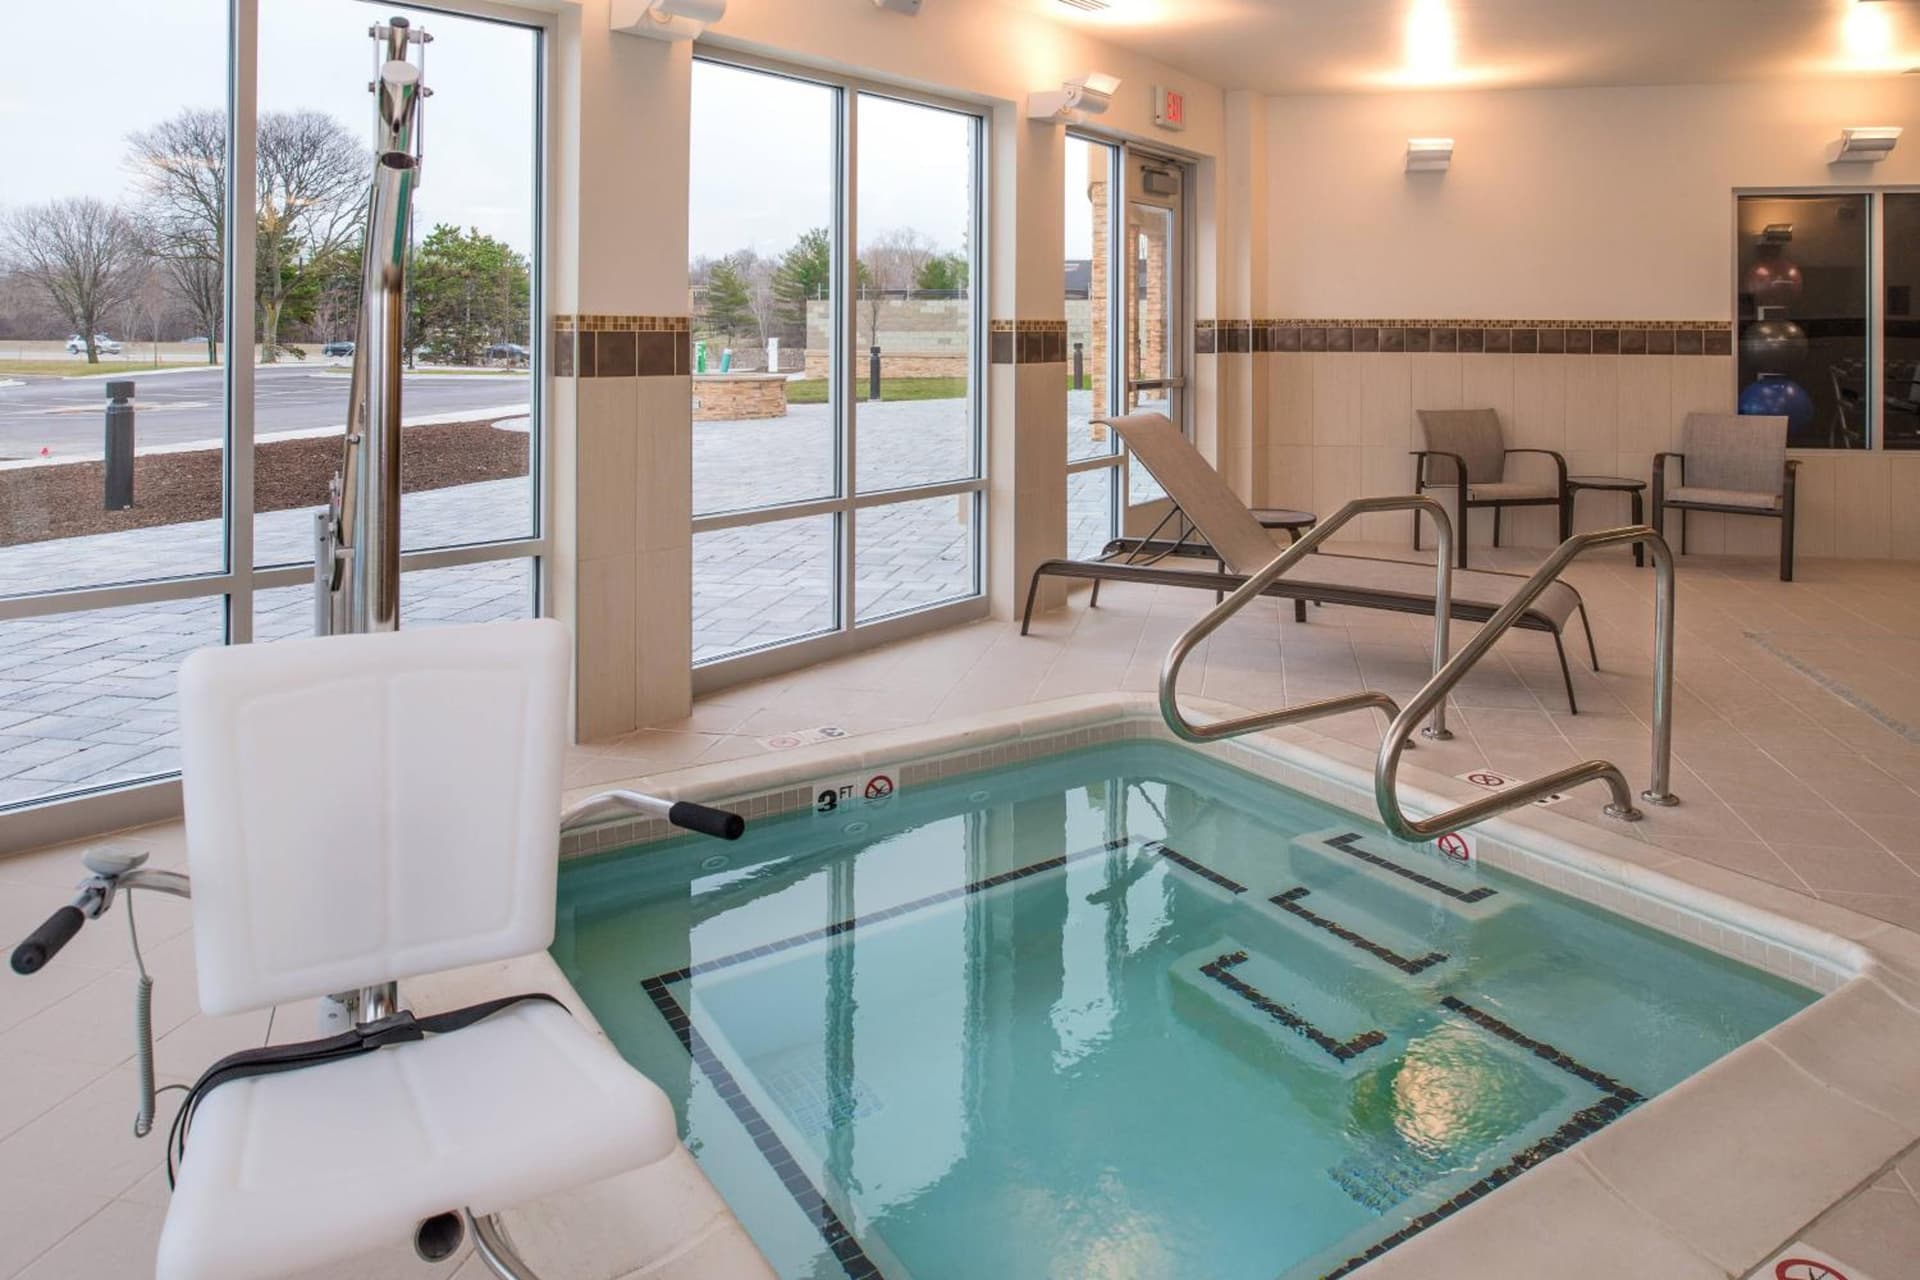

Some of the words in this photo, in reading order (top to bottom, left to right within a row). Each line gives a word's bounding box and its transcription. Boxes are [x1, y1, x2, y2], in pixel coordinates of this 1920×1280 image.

[1167, 91, 1183, 125] EXIT
[817, 789, 837, 812] 3
[840, 785, 854, 799] FT
